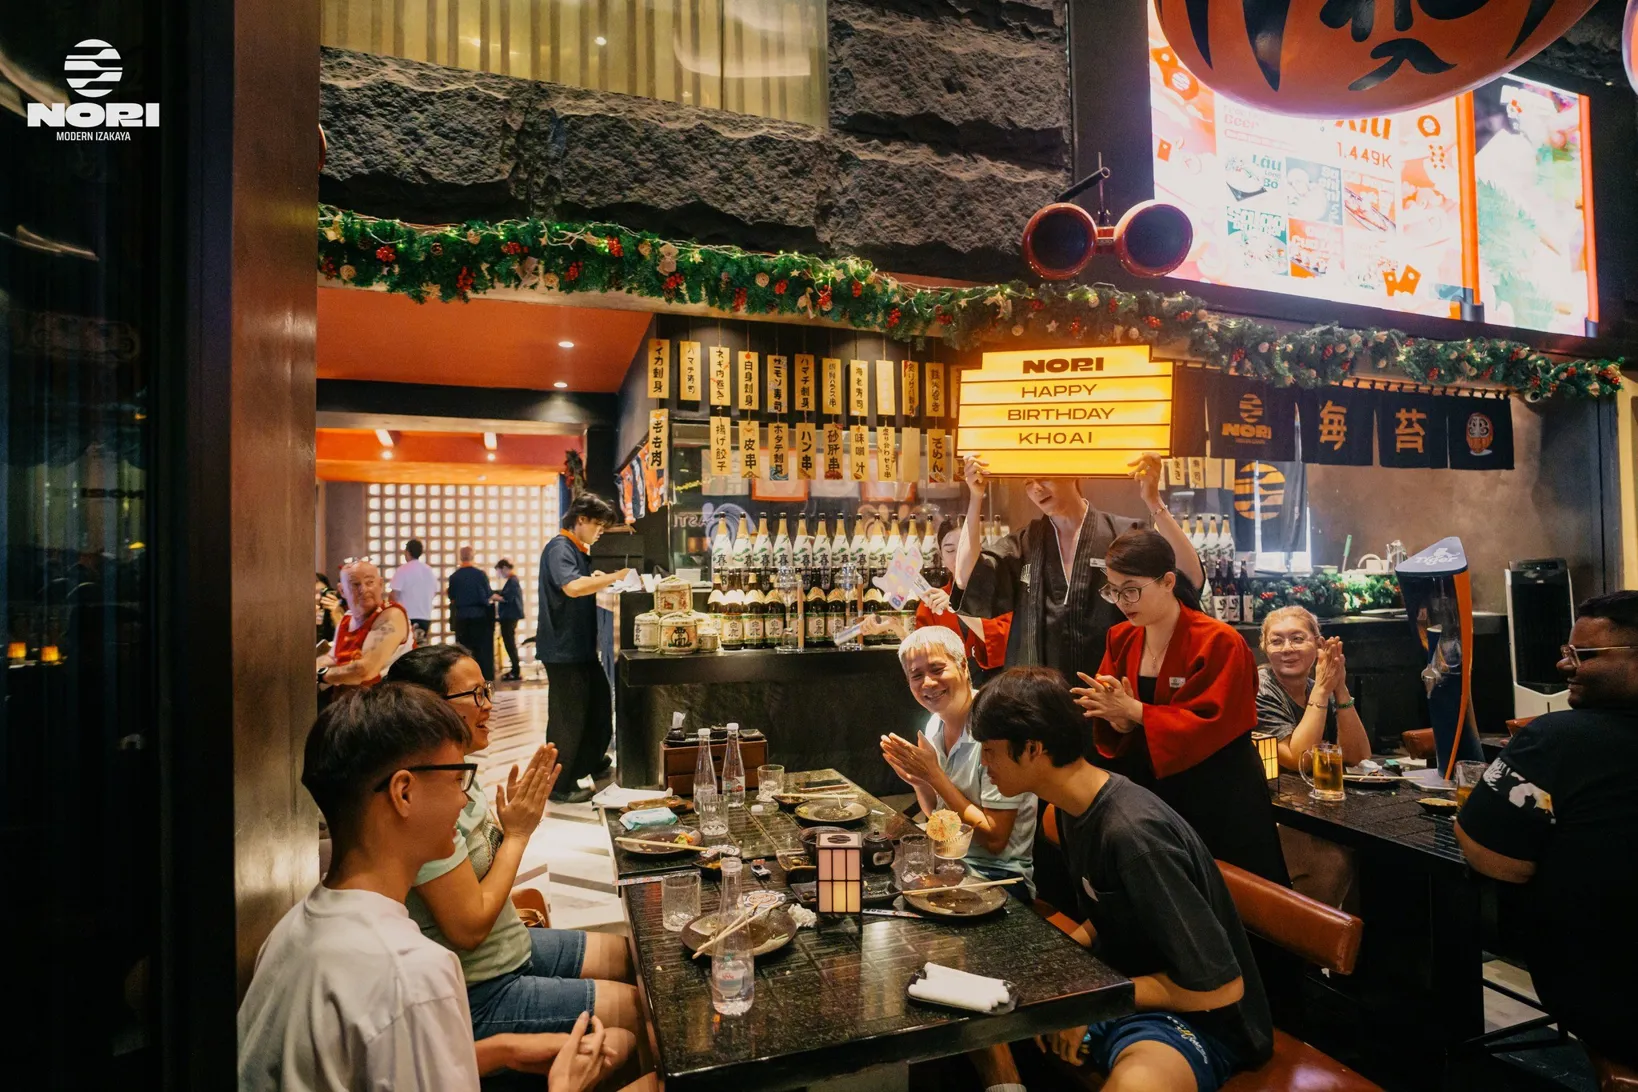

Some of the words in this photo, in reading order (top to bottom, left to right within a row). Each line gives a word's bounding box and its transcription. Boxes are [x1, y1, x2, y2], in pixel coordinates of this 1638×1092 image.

[1022, 357, 1104, 374] NORI
[1021, 384, 1097, 398] HAPPY
[1007, 408, 1115, 421] BIRTHDAY
[1019, 432, 1093, 444] KHOAI
[1222, 423, 1272, 440] NORI
[744, 438, 757, 470] 皮串
